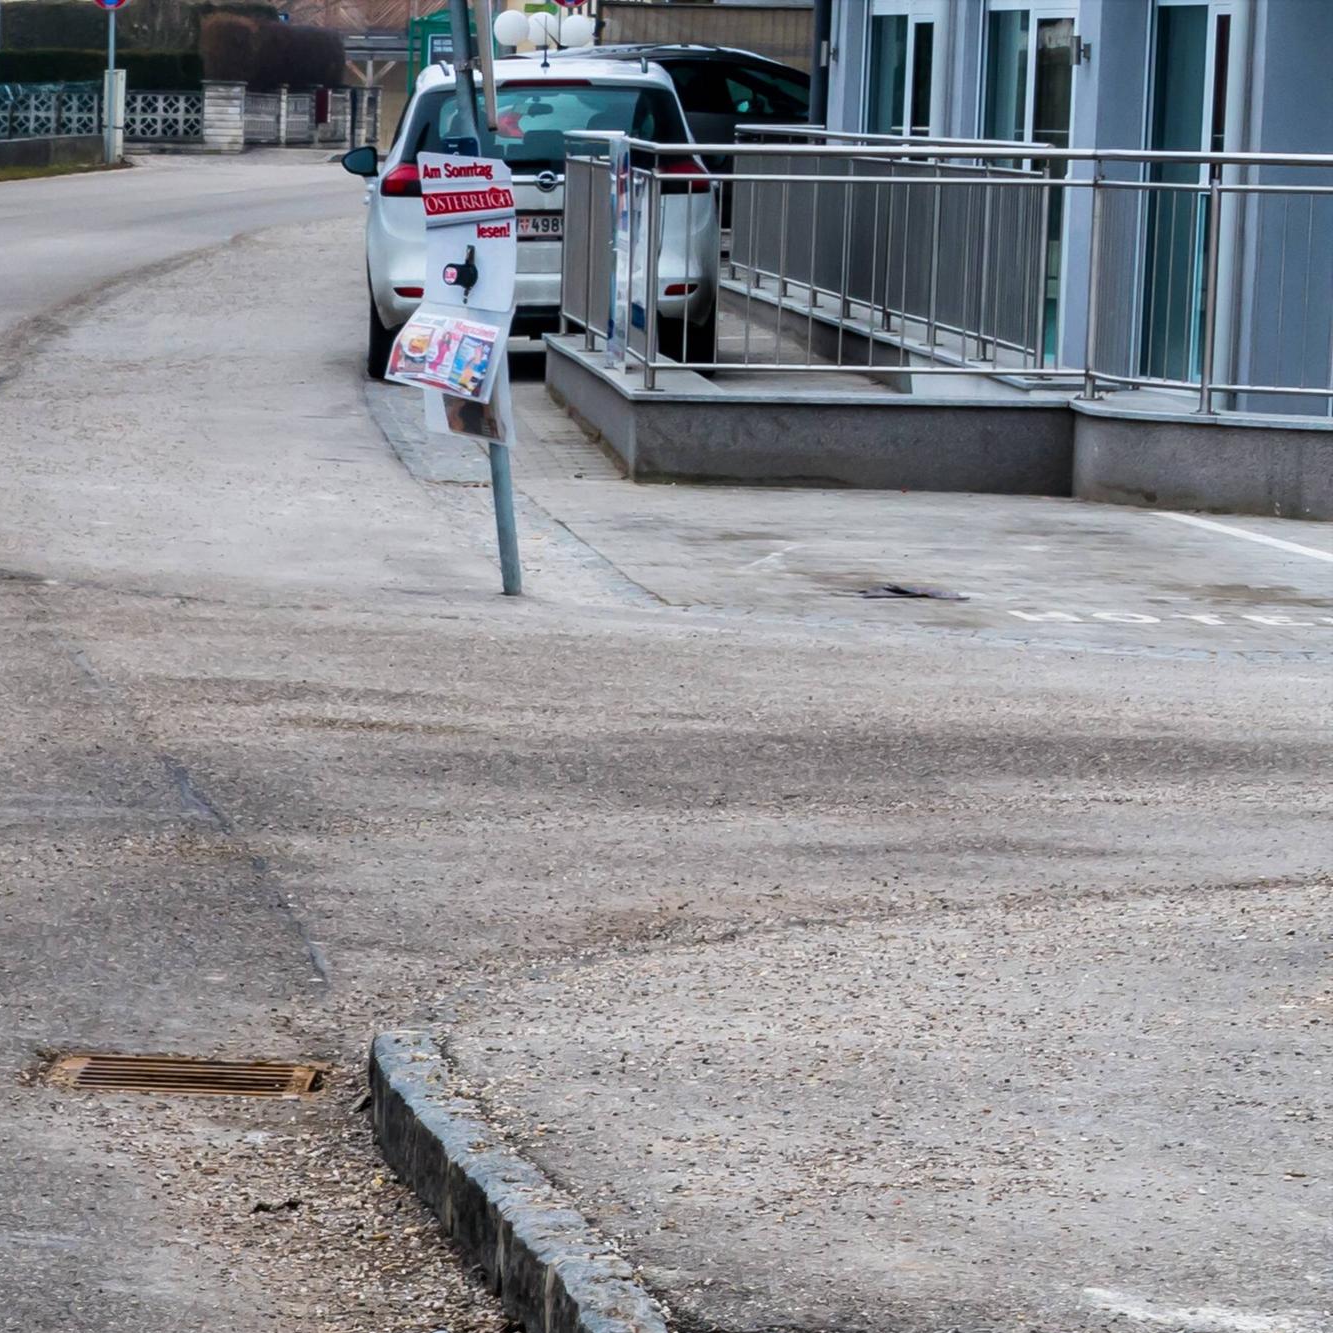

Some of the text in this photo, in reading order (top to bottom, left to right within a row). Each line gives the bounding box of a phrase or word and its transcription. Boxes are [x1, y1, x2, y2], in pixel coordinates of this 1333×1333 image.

[422, 161, 493, 181] Am Sonntag
[425, 191, 513, 213] ÖSTERREICH
[476, 222, 510, 239] lesen!
[1006, 609, 1333, 627] HOTE
